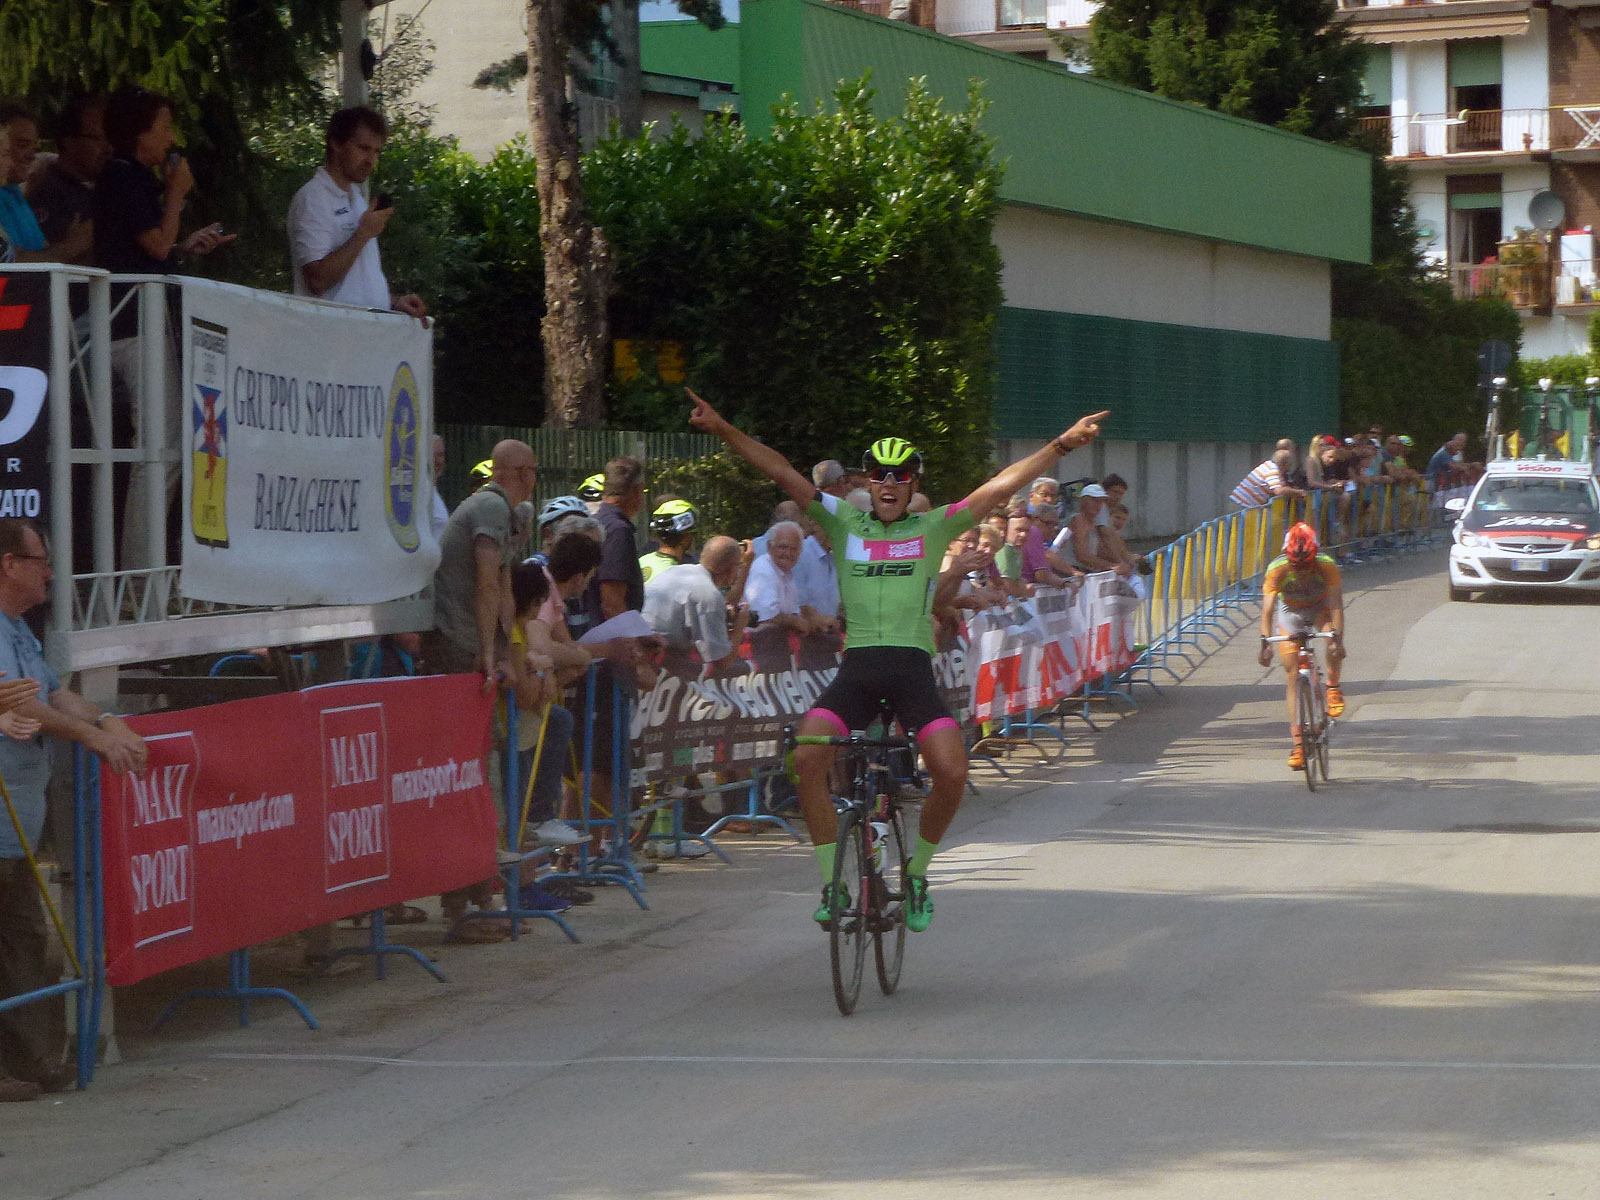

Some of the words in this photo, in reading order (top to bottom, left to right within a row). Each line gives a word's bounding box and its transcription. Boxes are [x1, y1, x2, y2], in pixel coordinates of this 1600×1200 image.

[233, 365, 299, 434] GRUPPO
[306, 380, 385, 439] SPORTIVO
[1517, 463, 1563, 473] vision
[0, 488, 40, 518] ATO
[254, 472, 361, 533] BARZAGHESE
[330, 731, 378, 788] MAXI
[391, 757, 484, 808] maxisport.com
[129, 763, 189, 827] MAXI
[196, 792, 295, 850] maxisport.com
[328, 803, 384, 864] SPORT
[130, 844, 189, 915] SPORT
